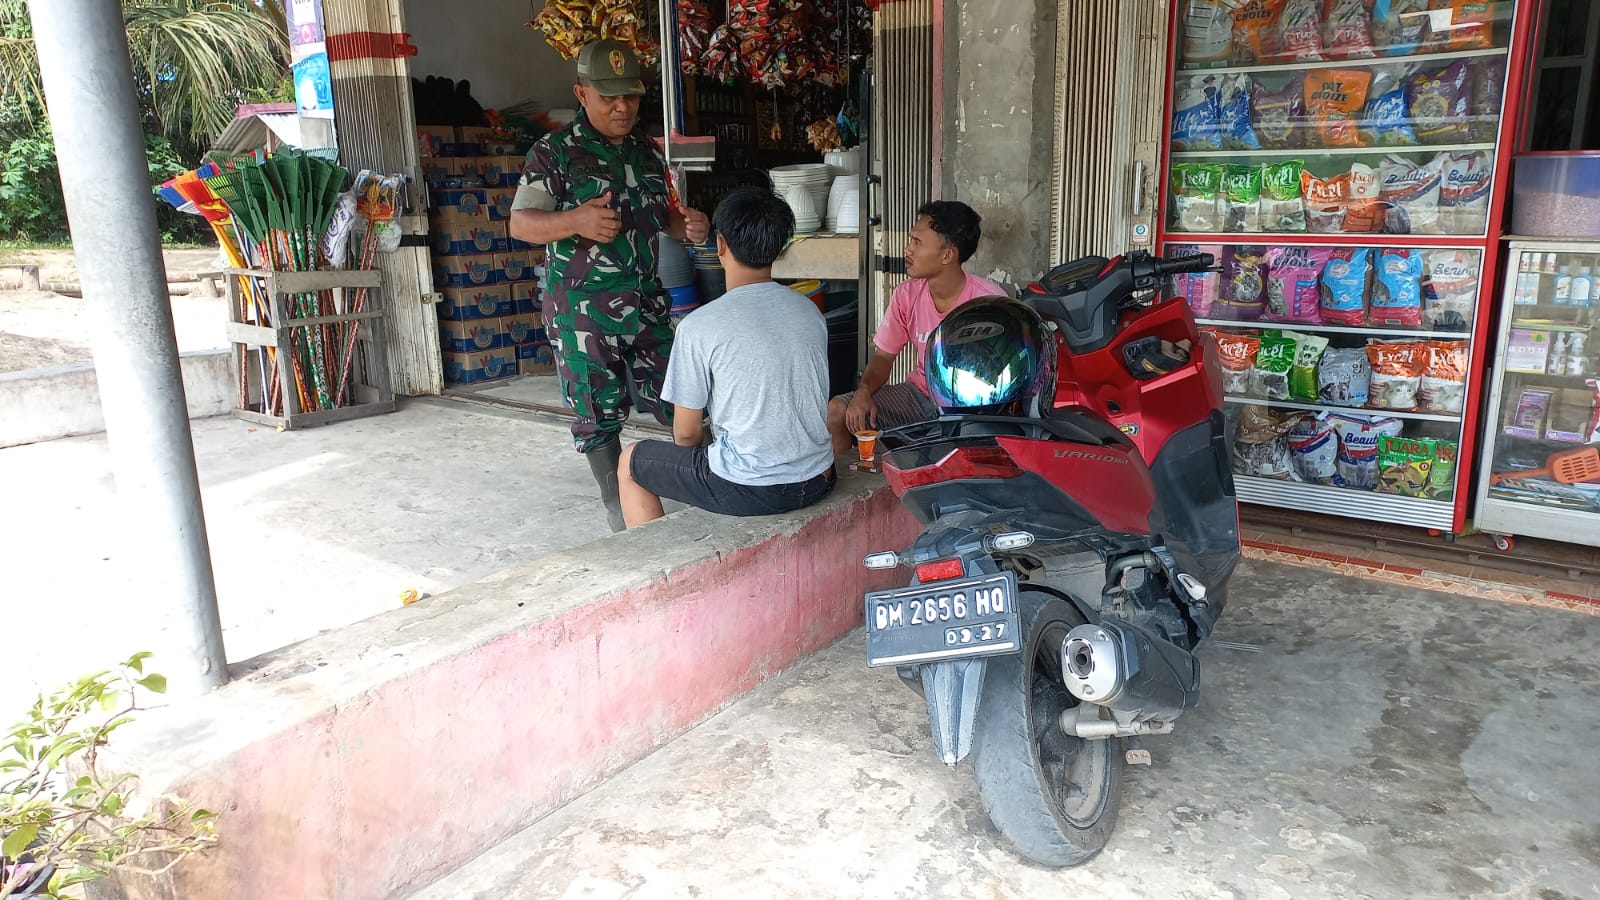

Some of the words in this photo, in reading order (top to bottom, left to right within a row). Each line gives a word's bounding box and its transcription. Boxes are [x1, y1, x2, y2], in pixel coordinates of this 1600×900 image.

[1306, 179, 1343, 199] Excel
[1383, 439, 1431, 456] JUARA
[910, 592, 967, 626] 2656
